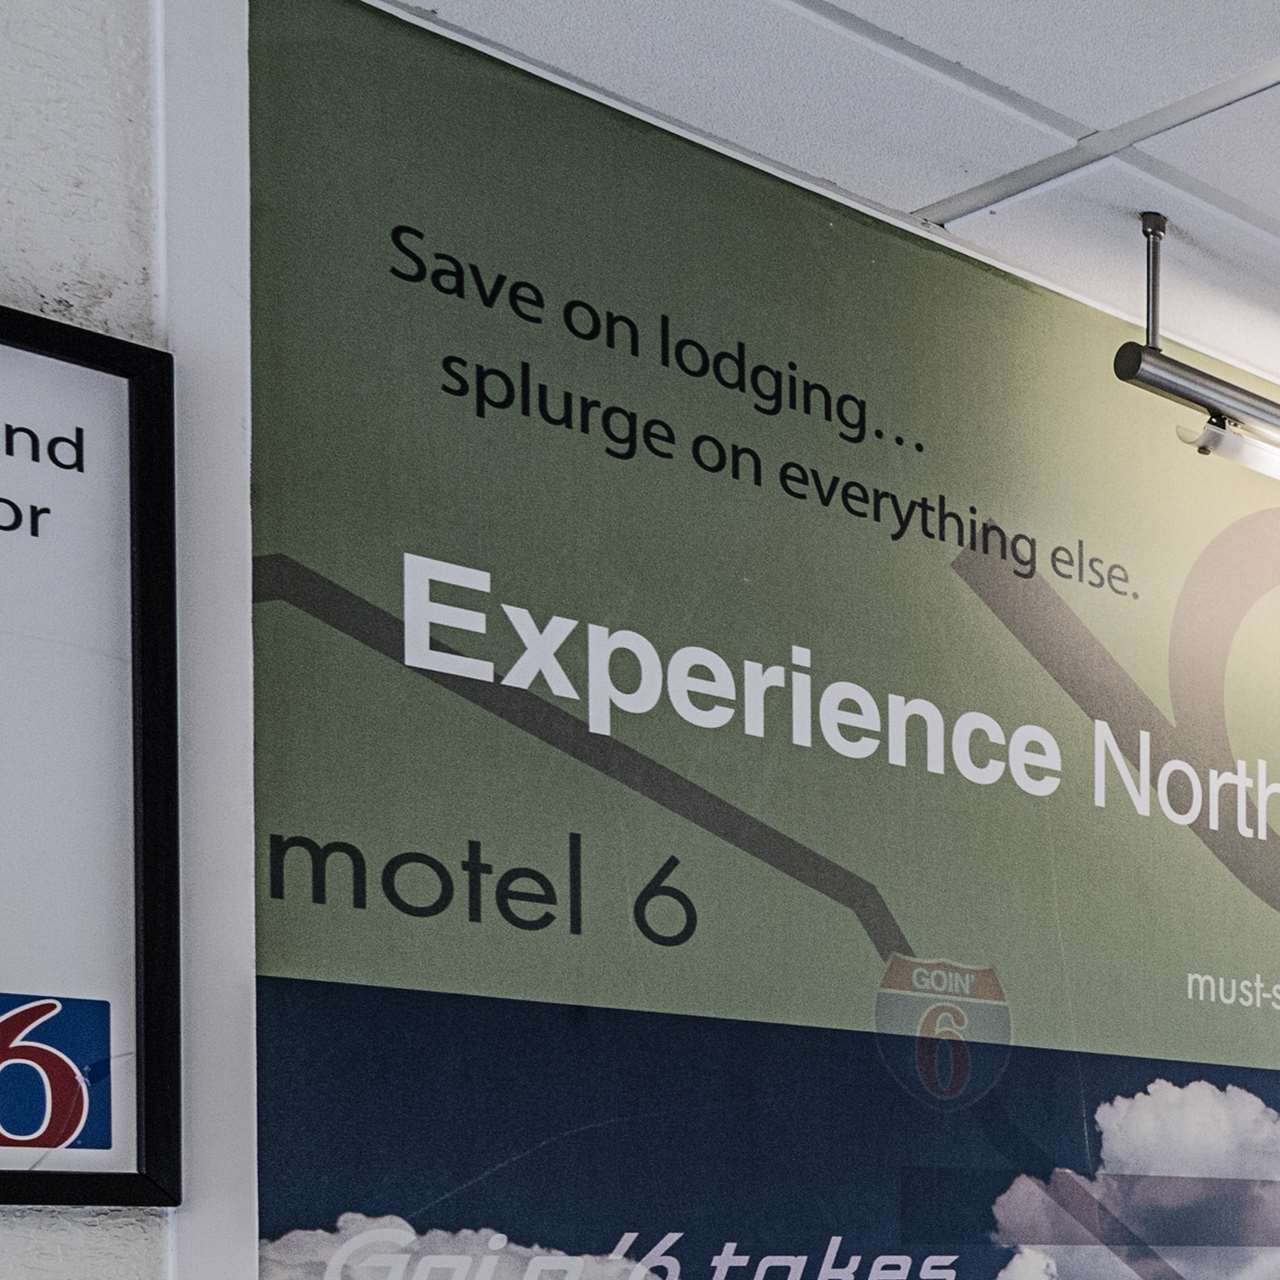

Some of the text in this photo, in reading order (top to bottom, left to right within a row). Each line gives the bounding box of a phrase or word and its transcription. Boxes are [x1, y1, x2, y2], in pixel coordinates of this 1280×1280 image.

[389, 225, 926, 453] Save on lodging...
[440, 355, 1140, 600] splurge on everything else.
[403, 552, 1063, 797] Experience
[269, 832, 698, 947] motel 6
[912, 967, 976, 994] GOIN'
[916, 1002, 972, 1100] 6
[0, 1000, 90, 1148] 6
